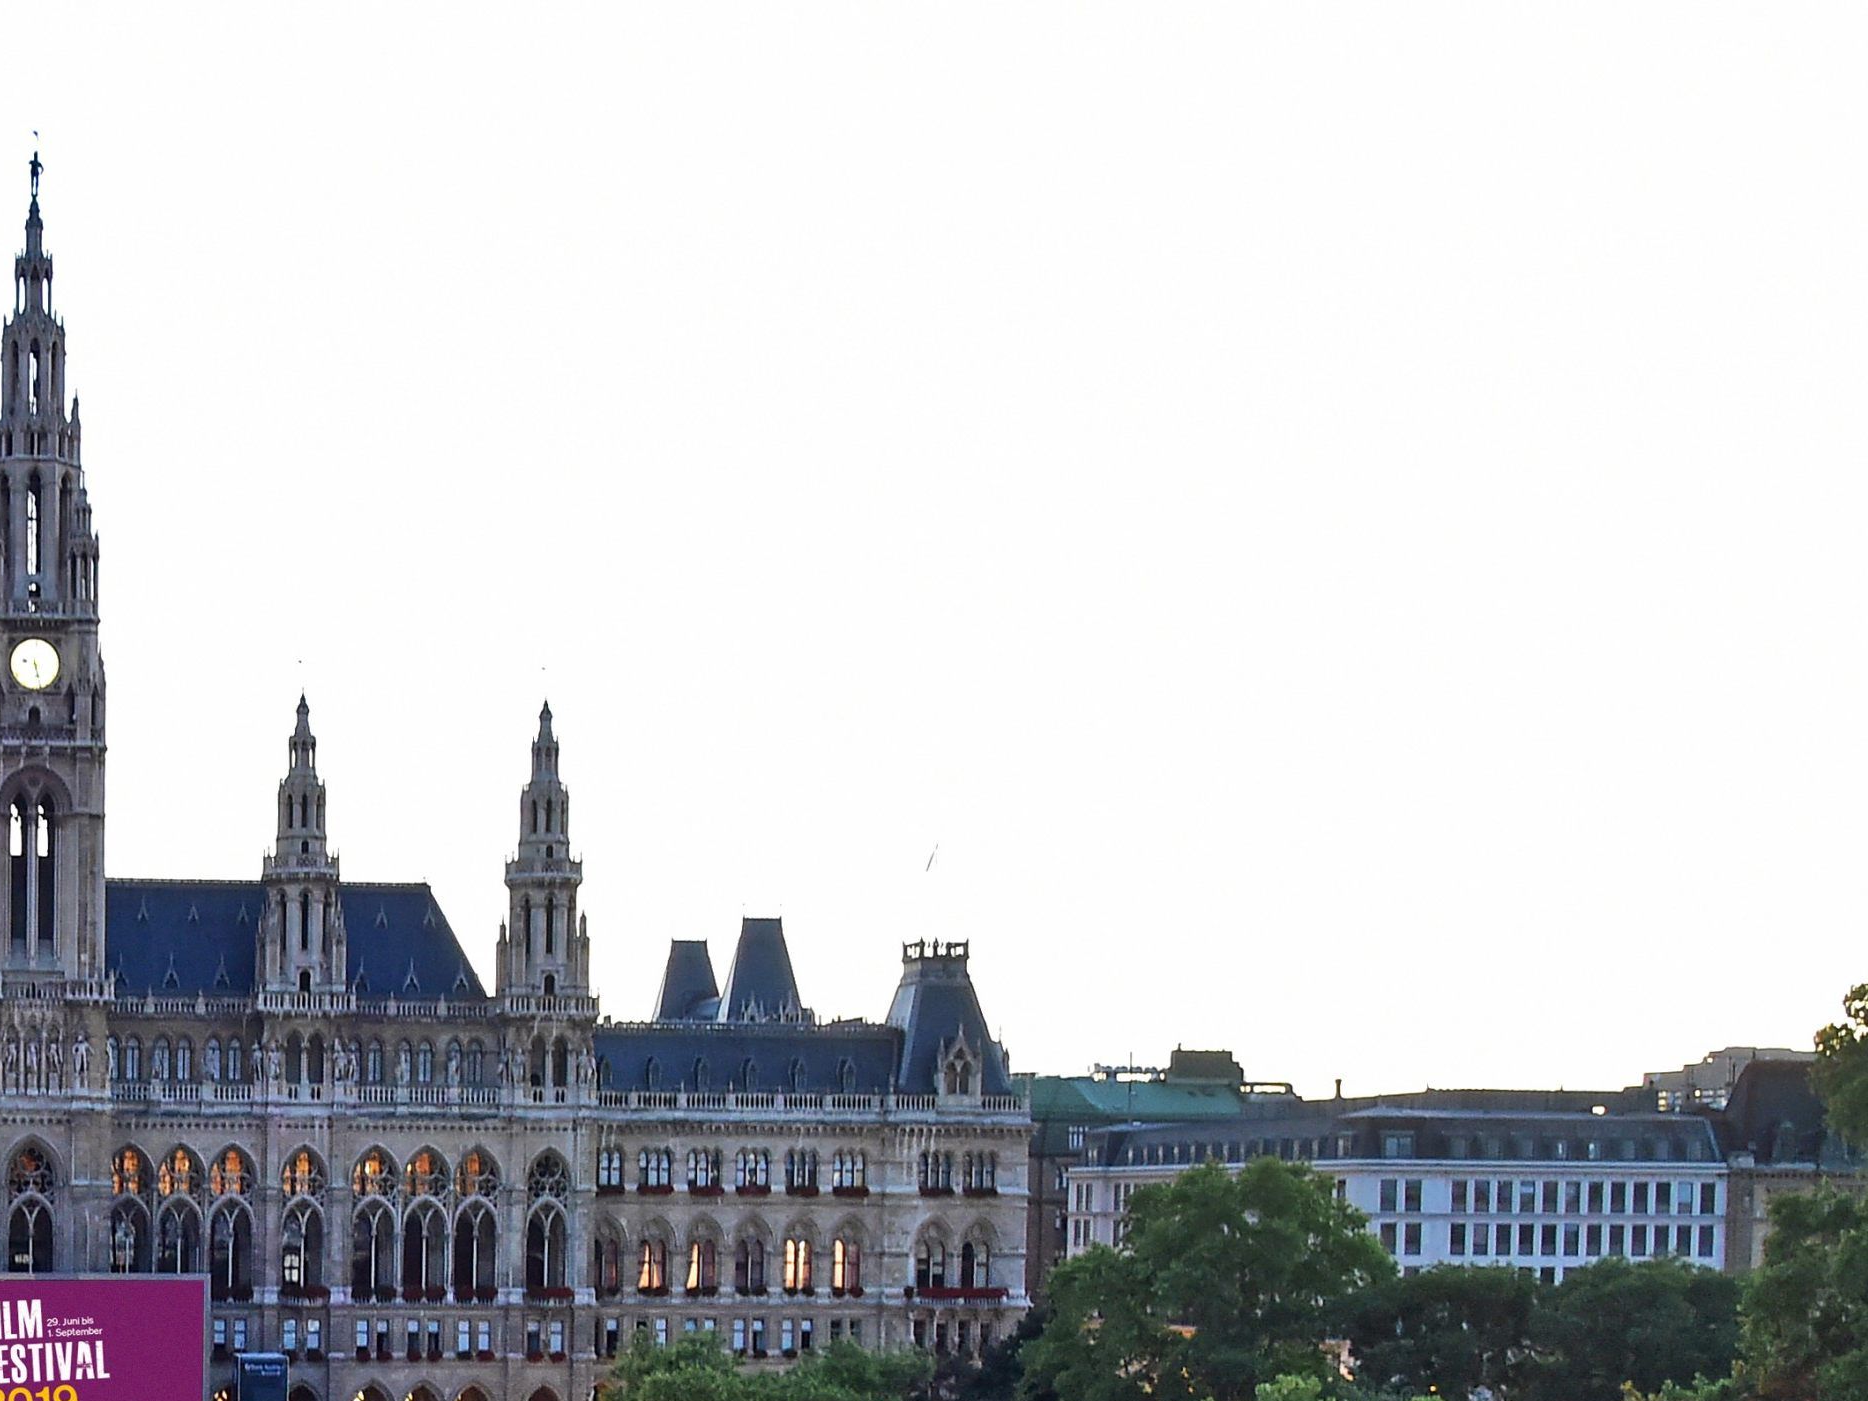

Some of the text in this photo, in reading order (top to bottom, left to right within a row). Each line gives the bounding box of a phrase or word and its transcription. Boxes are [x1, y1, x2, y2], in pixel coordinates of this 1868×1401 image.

[46, 1316, 95, 1328] 29. Juni bis
[47, 1327, 103, 1338] 1. September
